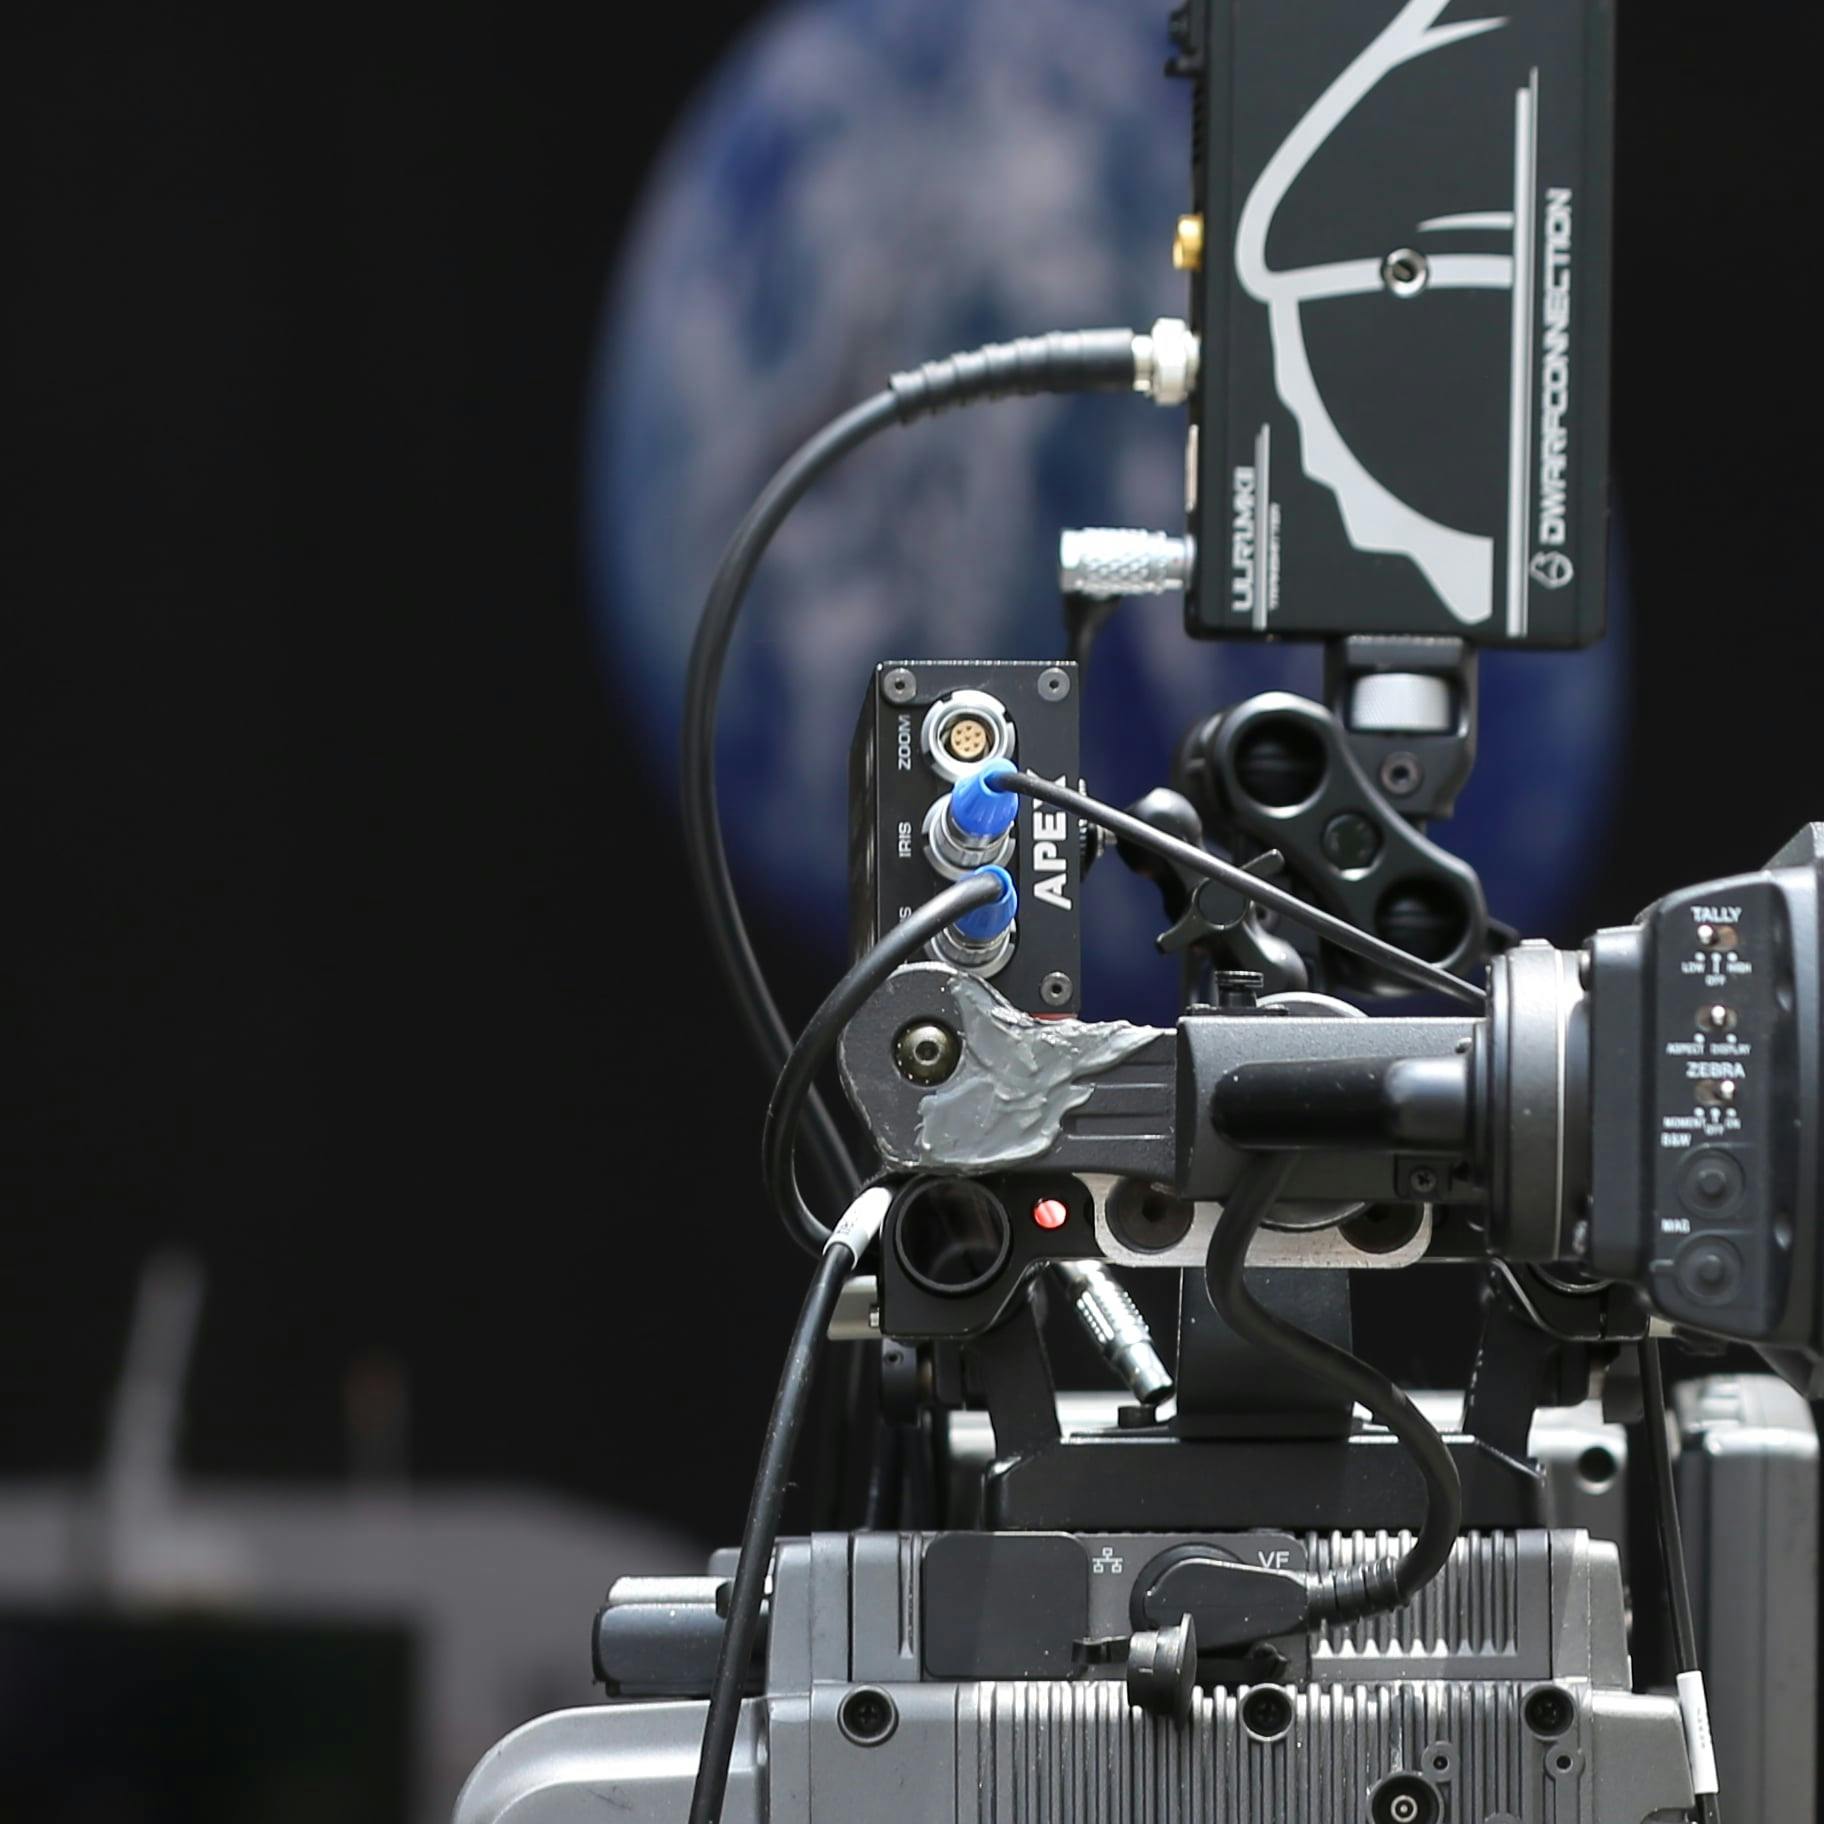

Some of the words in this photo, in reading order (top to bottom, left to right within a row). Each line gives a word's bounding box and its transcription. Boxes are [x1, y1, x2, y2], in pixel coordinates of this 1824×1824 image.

[1539, 188, 1572, 545] DWARFCONNECTION
[898, 714, 912, 770] ZOOM
[898, 821, 912, 858] IRIS
[1690, 906, 1742, 923] TALLY
[1686, 1061, 1746, 1078] ZEBRA
[1258, 1551, 1290, 1568] VF
